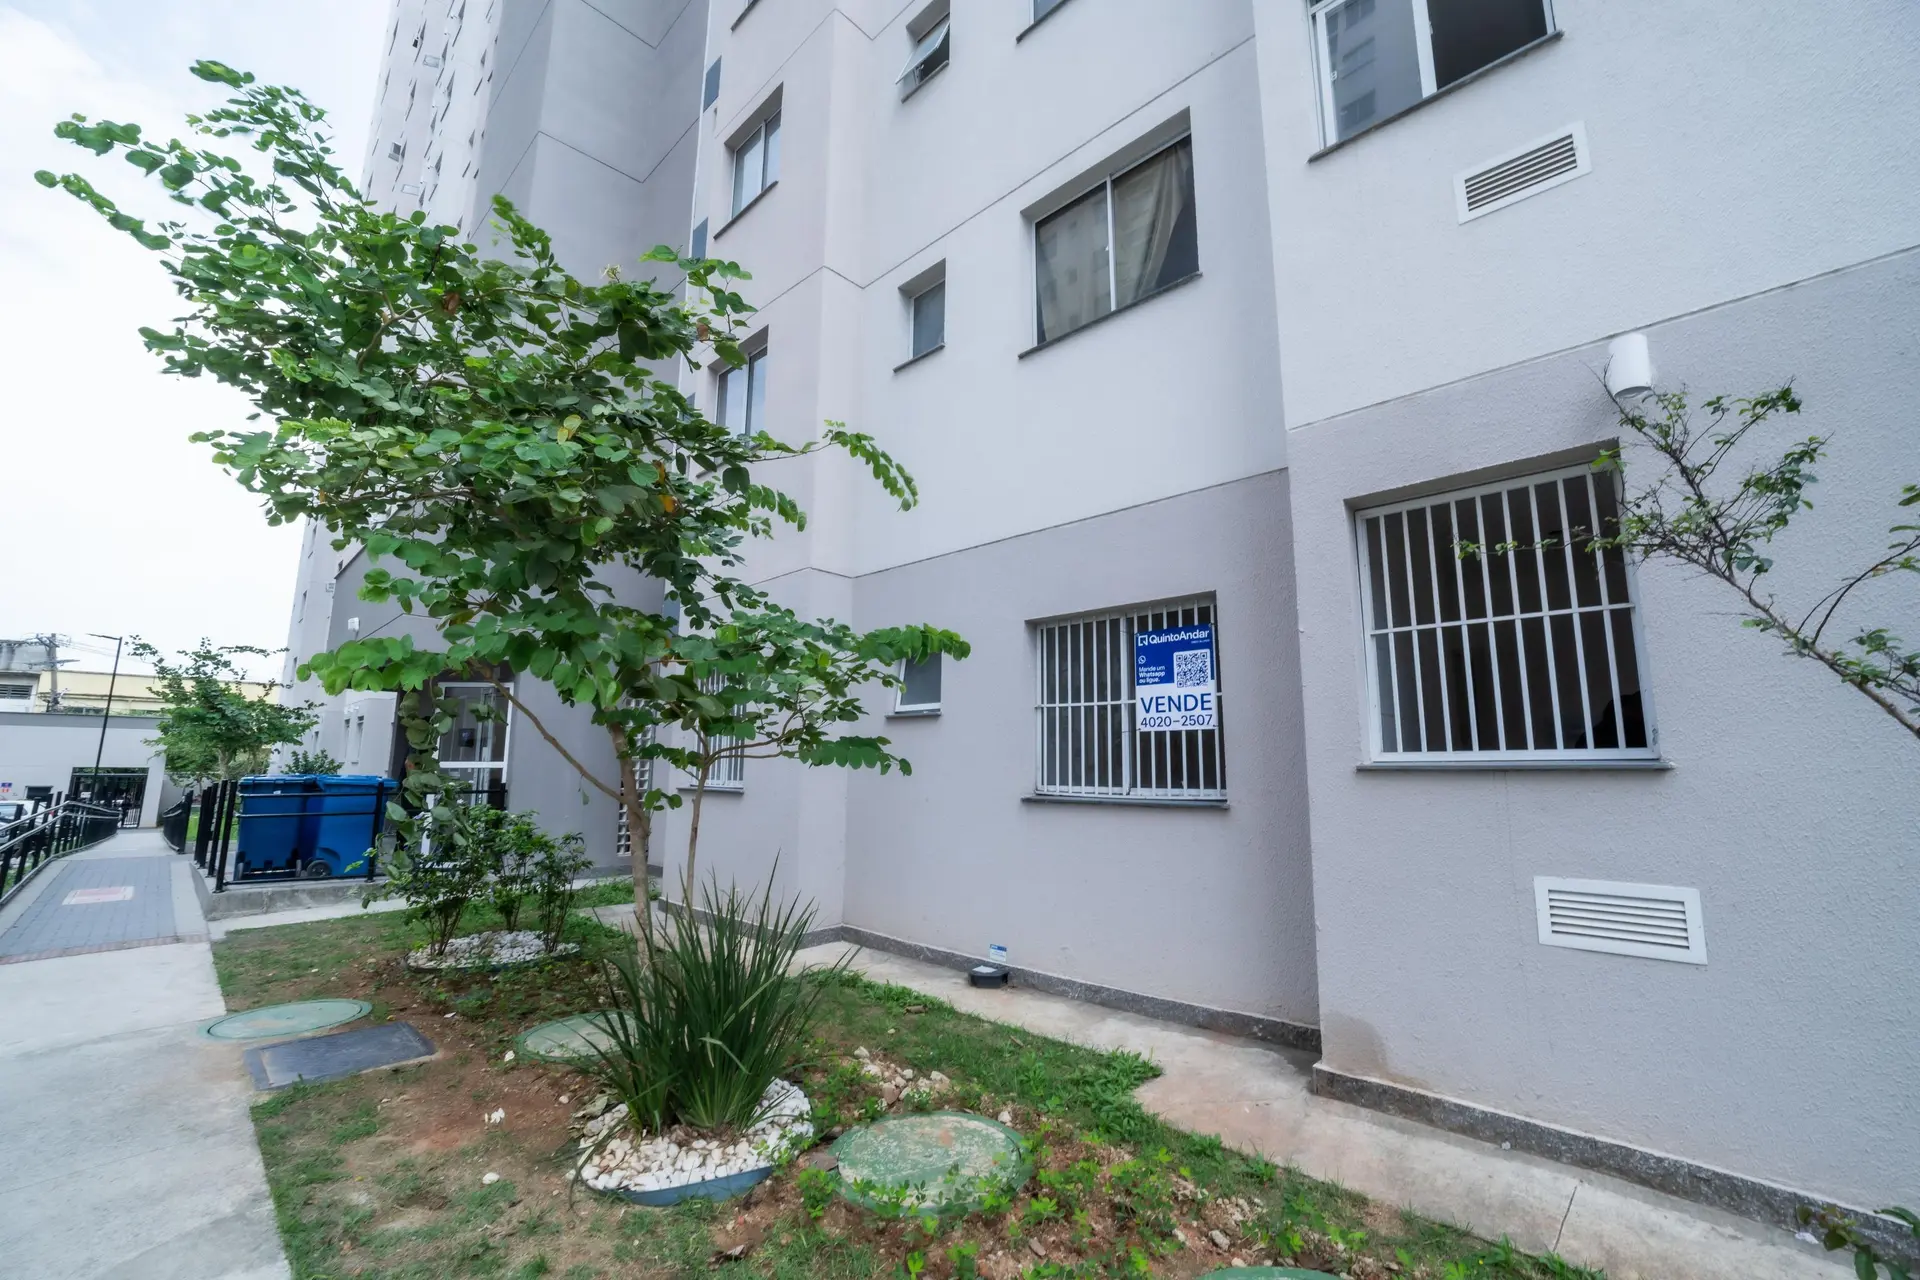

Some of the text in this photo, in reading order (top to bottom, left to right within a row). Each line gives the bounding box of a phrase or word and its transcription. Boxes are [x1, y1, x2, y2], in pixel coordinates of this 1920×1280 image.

[1149, 629, 1209, 644] QuintoAndar
[1140, 693, 1212, 713] VENDE
[1140, 714, 1212, 728] 4020-2507
